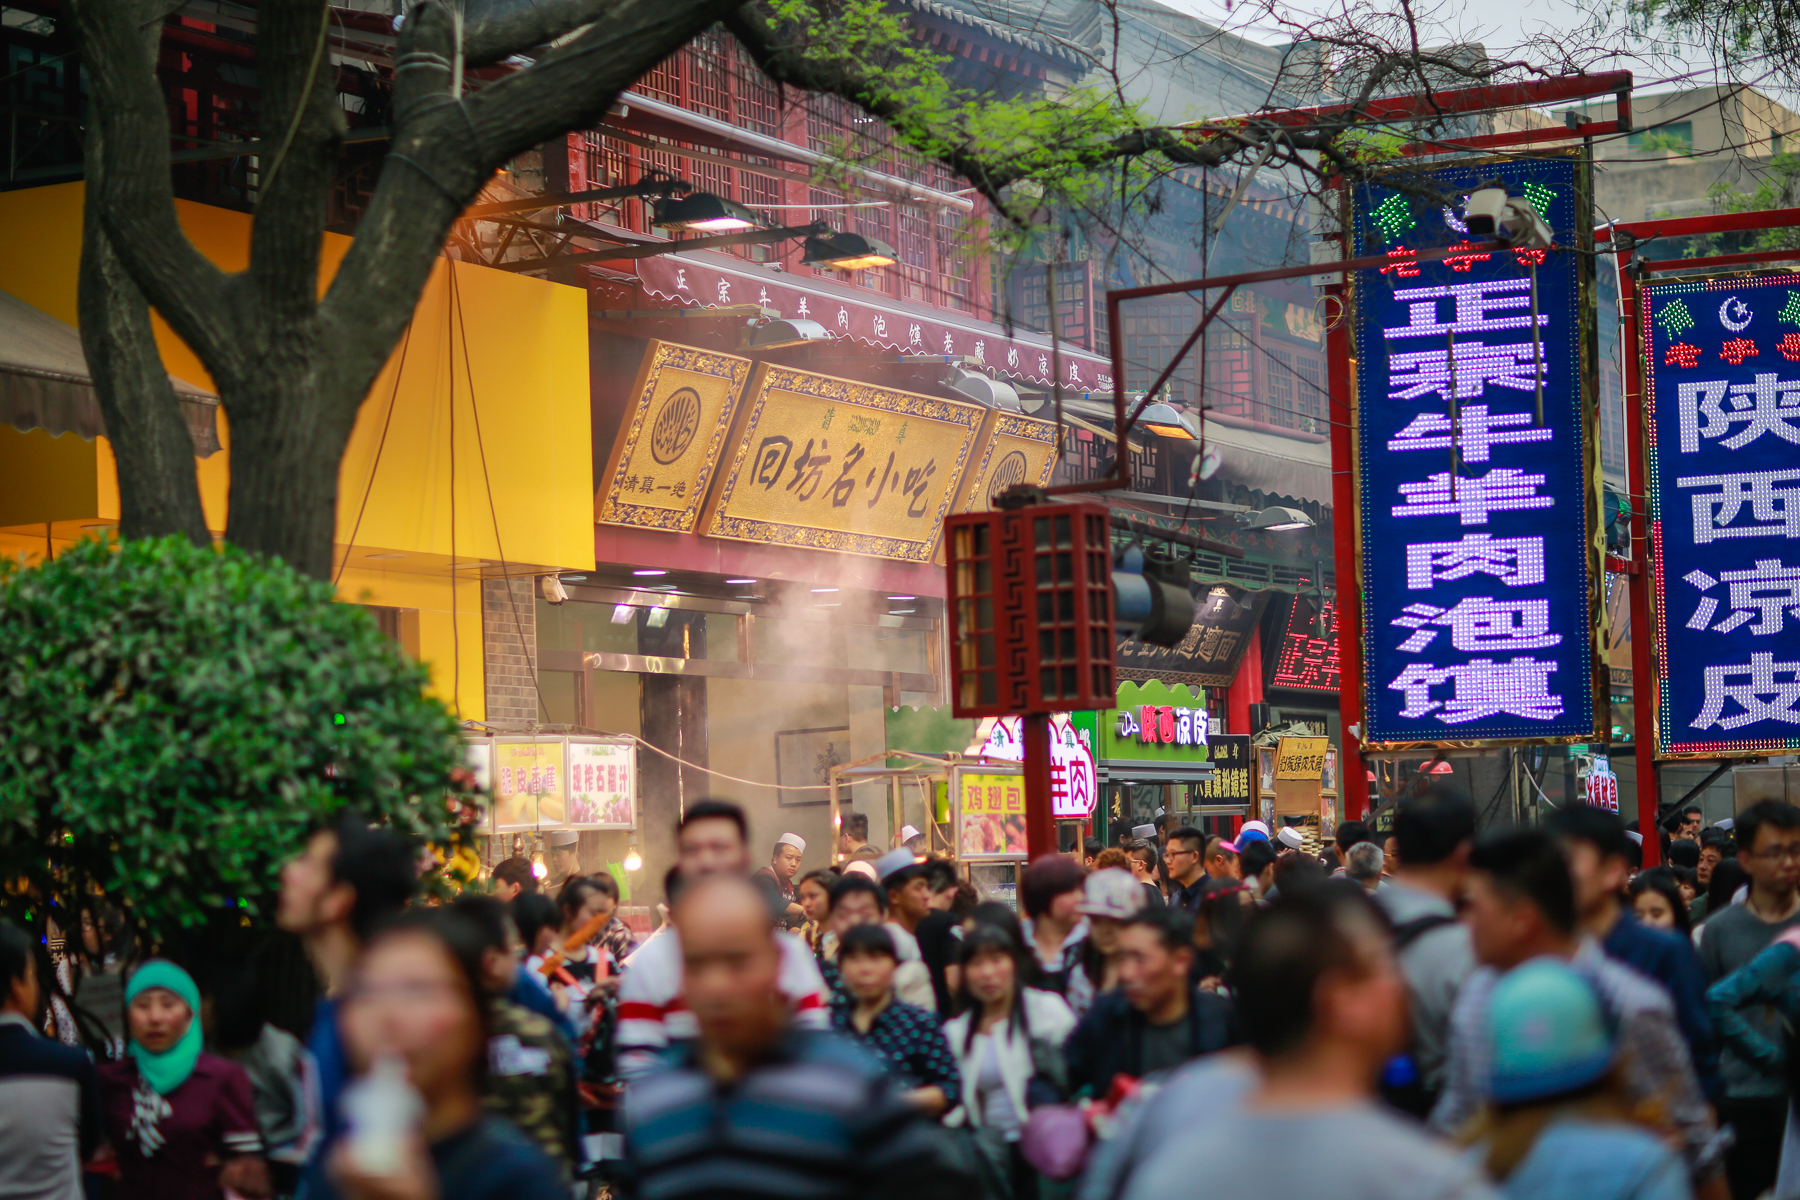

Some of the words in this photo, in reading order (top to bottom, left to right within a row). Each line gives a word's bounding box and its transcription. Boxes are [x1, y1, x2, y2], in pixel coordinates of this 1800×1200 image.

[623, 474, 687, 499] 清真一绝
[750, 435, 937, 518] 回坊名小吃
[1384, 278, 1564, 724] 正宗牛羊肉泡馍
[1677, 372, 1800, 731] 陕西凉皮
[1141, 705, 1208, 746] 陕西凉皮
